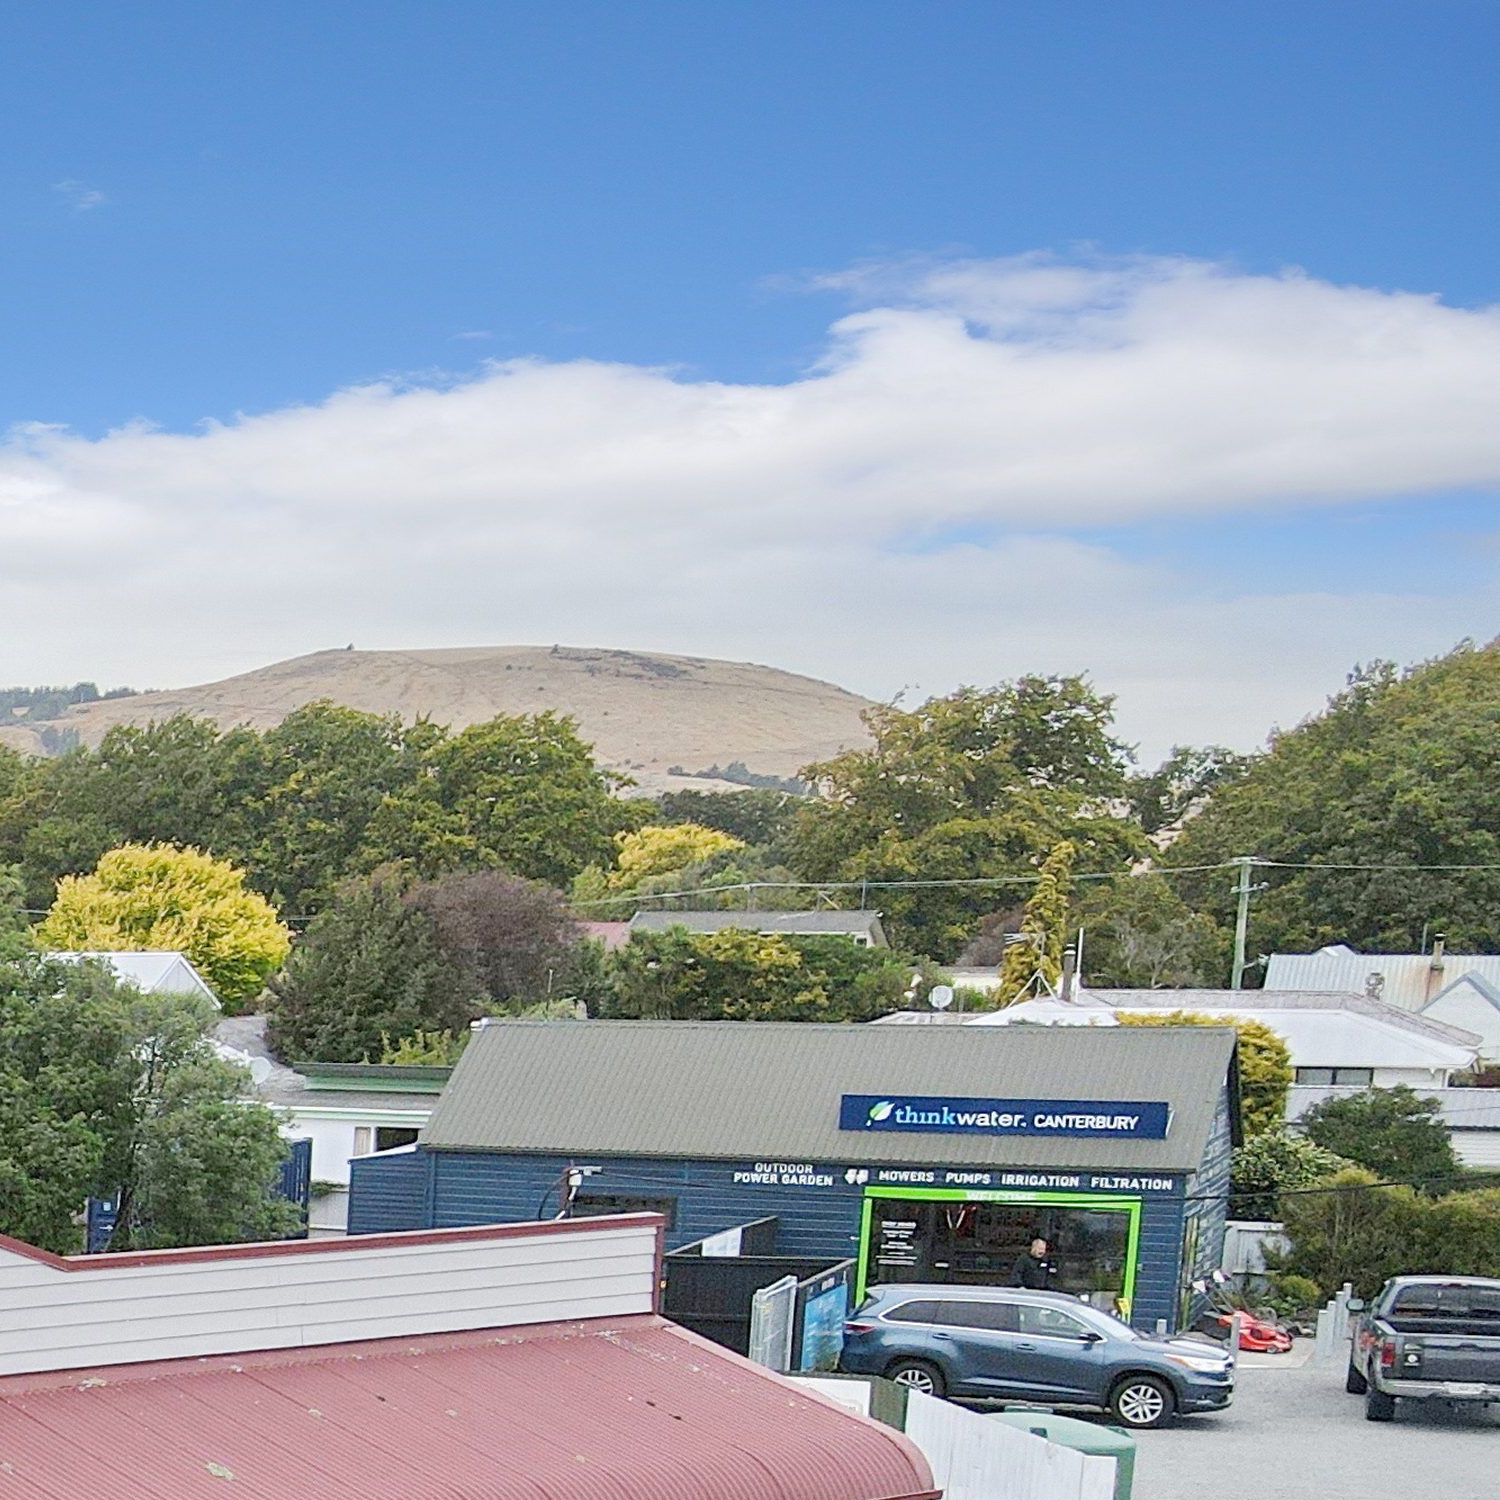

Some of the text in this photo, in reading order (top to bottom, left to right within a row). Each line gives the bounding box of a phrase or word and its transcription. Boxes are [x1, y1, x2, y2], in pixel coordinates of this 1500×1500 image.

[1033, 1113, 1140, 1131] CANTERBURY
[755, 1162, 814, 1174] OUTDOOR
[733, 1172, 834, 1187] POWER GARDEN
[878, 1170, 1173, 1191] MOWERS PUMPS IRRIGATION FILTRATION
